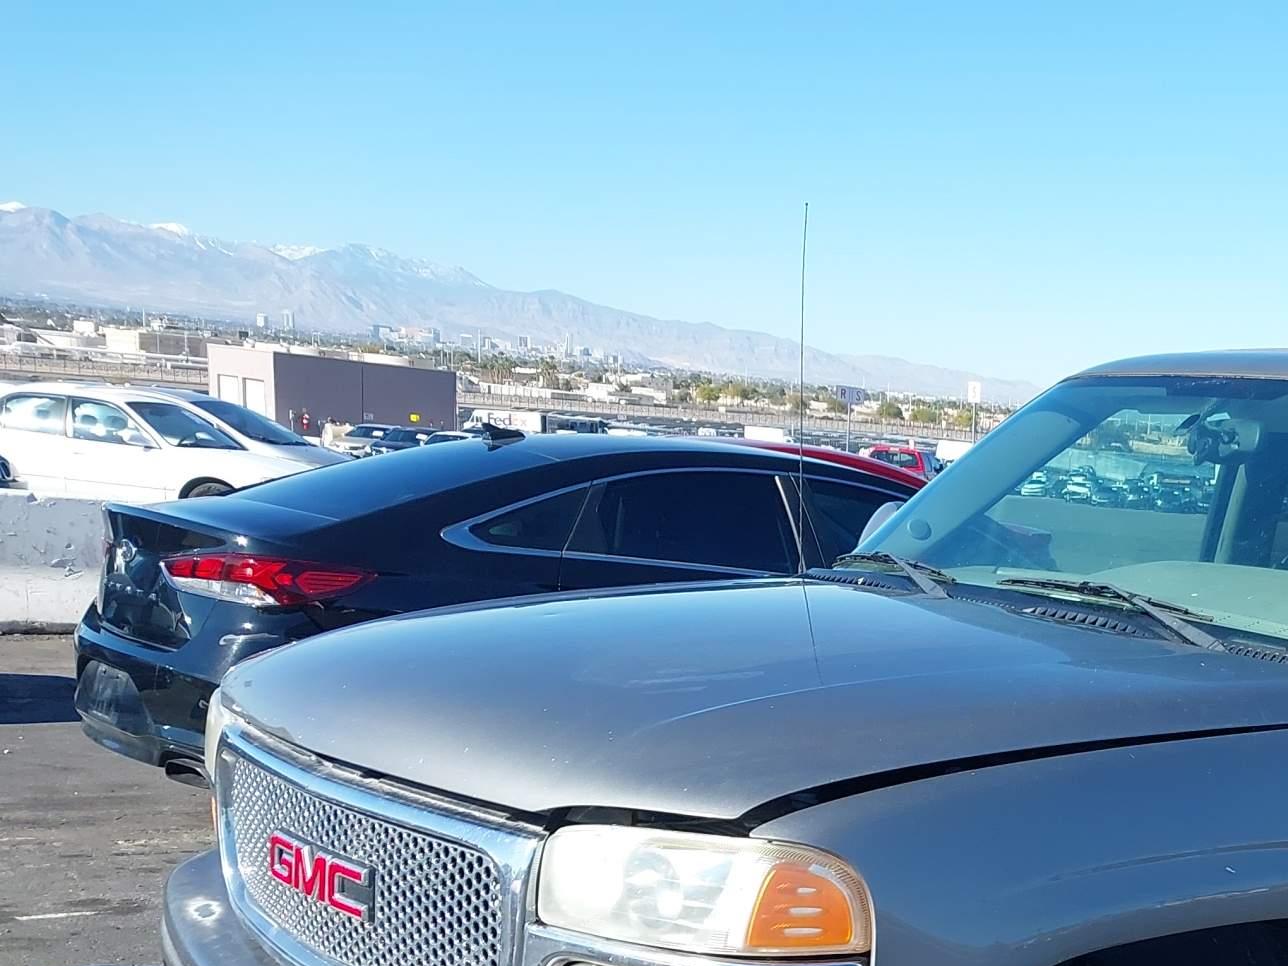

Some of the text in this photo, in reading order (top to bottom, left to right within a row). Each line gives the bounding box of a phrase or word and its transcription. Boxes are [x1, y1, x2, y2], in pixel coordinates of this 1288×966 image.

[840, 388, 847, 400] R
[855, 390, 862, 402] S
[487, 411, 528, 427] FedEx
[269, 832, 368, 921] GMC
